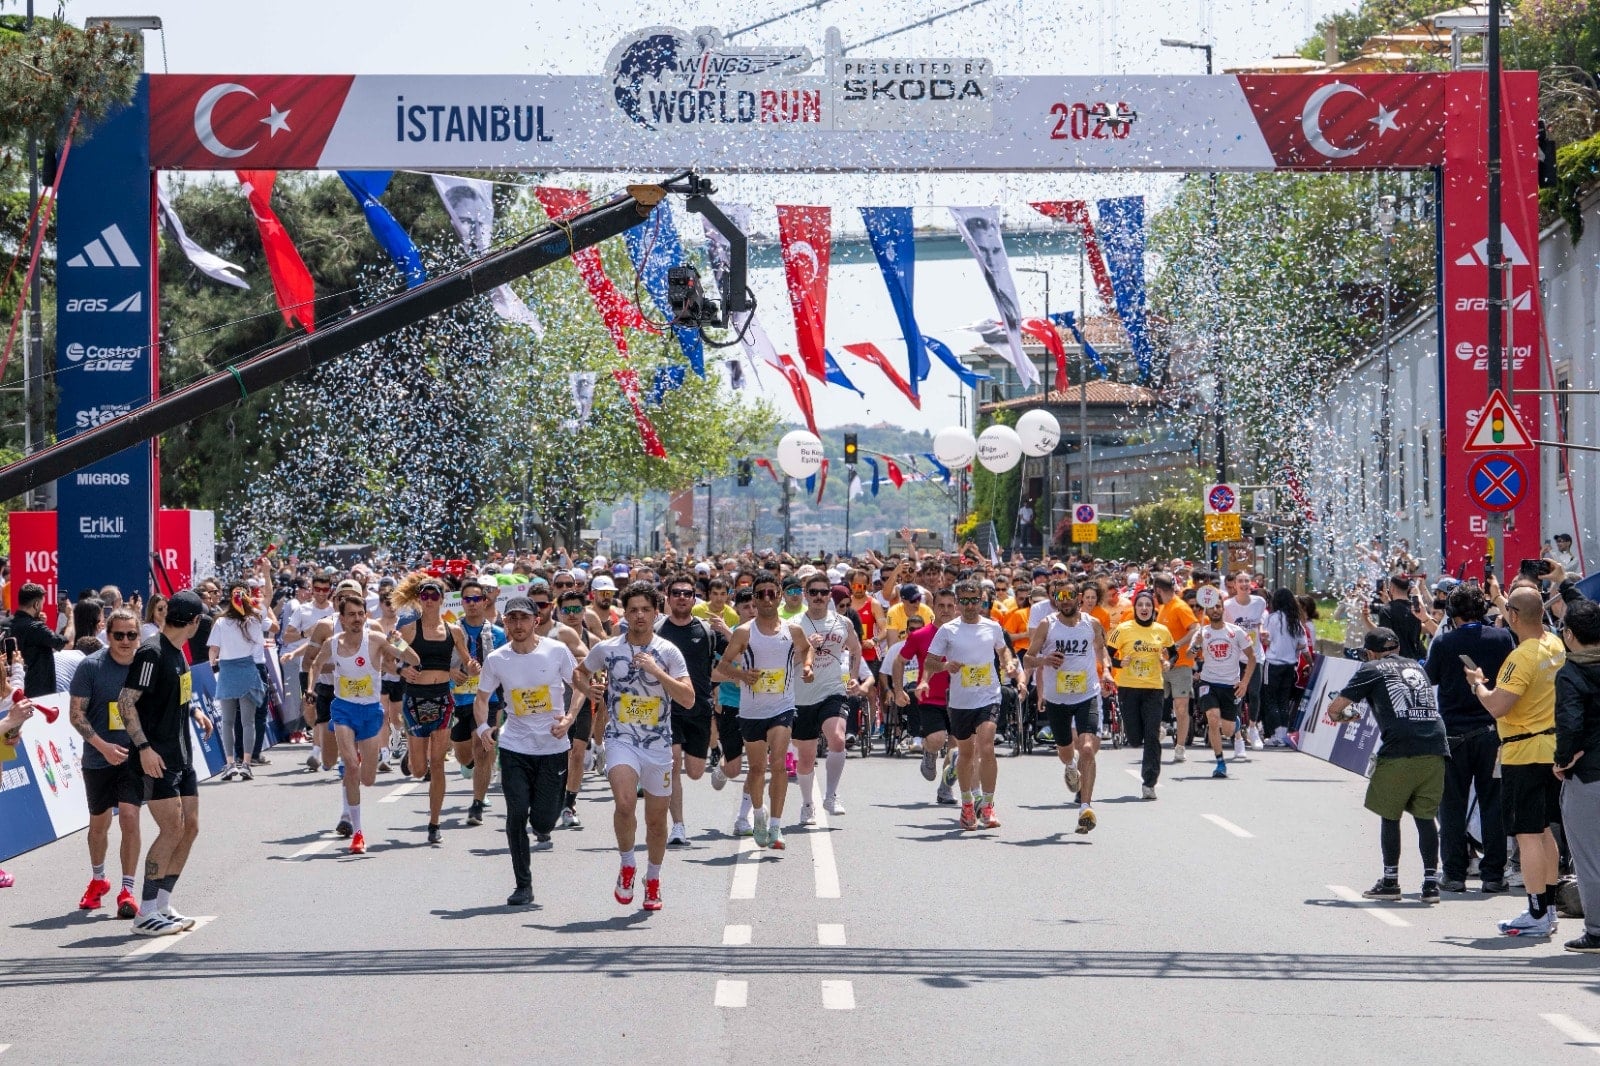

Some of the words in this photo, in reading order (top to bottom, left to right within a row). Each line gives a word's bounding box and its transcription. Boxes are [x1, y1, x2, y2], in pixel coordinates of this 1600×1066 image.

[845, 63, 953, 75] PRESENTED
[964, 63, 986, 75] BY
[396, 95, 554, 142] İSTANBUL
[66, 298, 109, 312] aras
[1455, 298, 1489, 311] ara
[86, 345, 142, 359] Castrol
[83, 359, 134, 372] EDGE
[77, 473, 130, 485] MIGROS
[79, 516, 124, 533] Erikli
